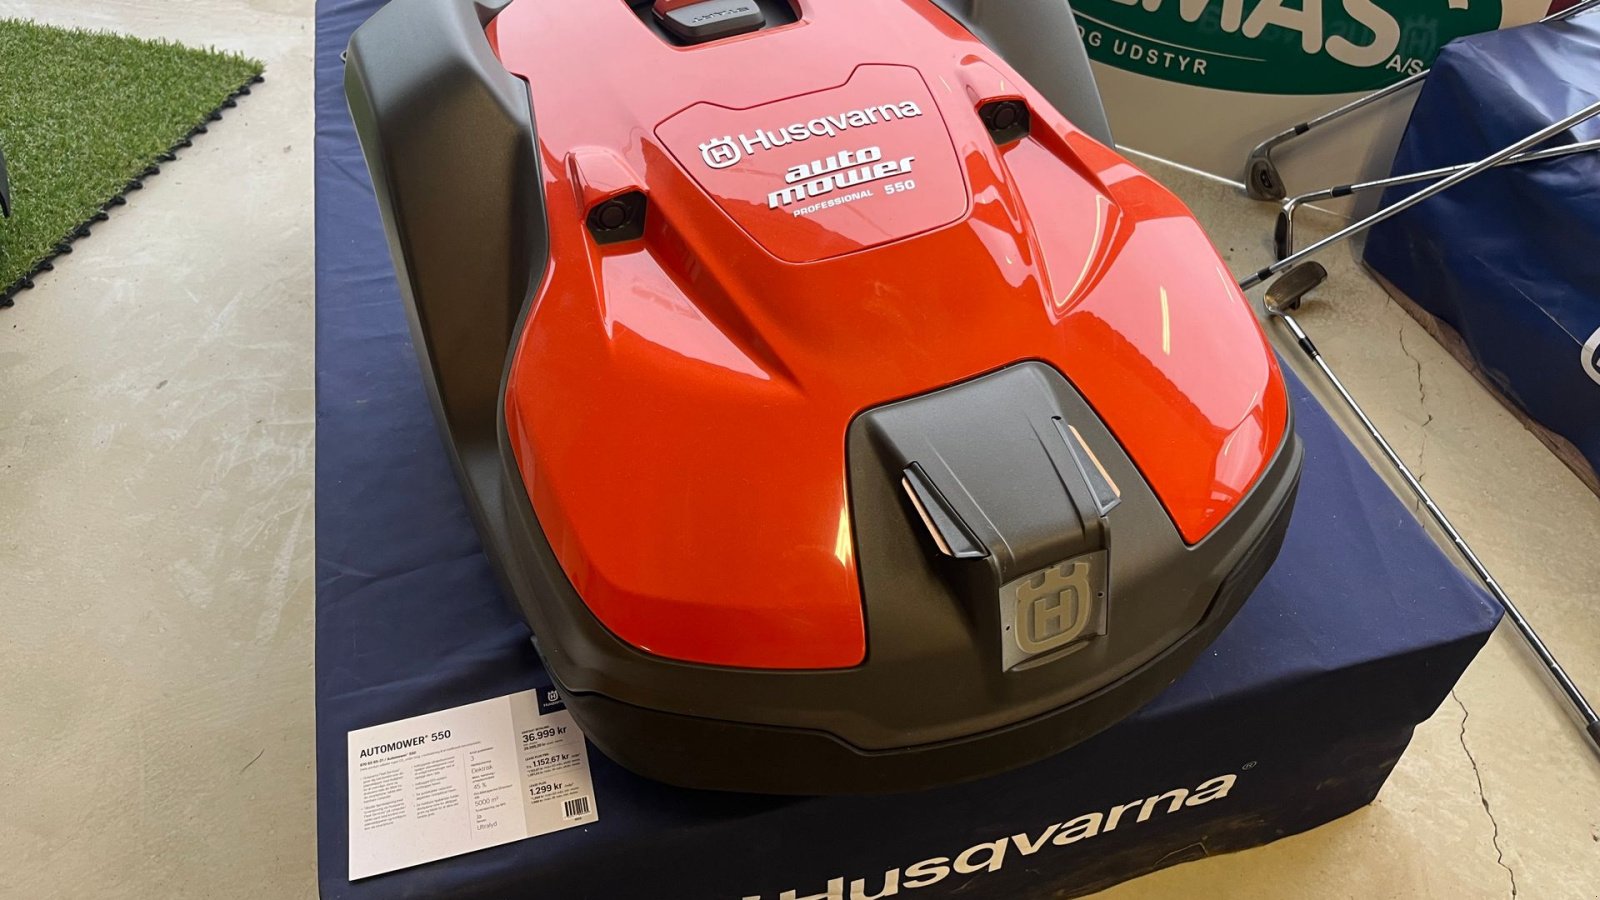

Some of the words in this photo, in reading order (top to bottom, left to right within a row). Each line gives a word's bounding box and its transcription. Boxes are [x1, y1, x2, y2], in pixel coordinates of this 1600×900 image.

[1113, 39, 1207, 75] UDSTYR
[738, 101, 922, 155] Husqvarna
[767, 156, 915, 209] mower
[785, 146, 882, 184] auto
[793, 189, 874, 218] PROFESSIONAL
[884, 179, 916, 195] 550
[431, 729, 451, 742] 550
[522, 728, 556, 743] 36.999
[557, 726, 567, 735] kr
[475, 798, 490, 807] 5000
[529, 784, 552, 796] 1.299
[553, 782, 563, 791] kr
